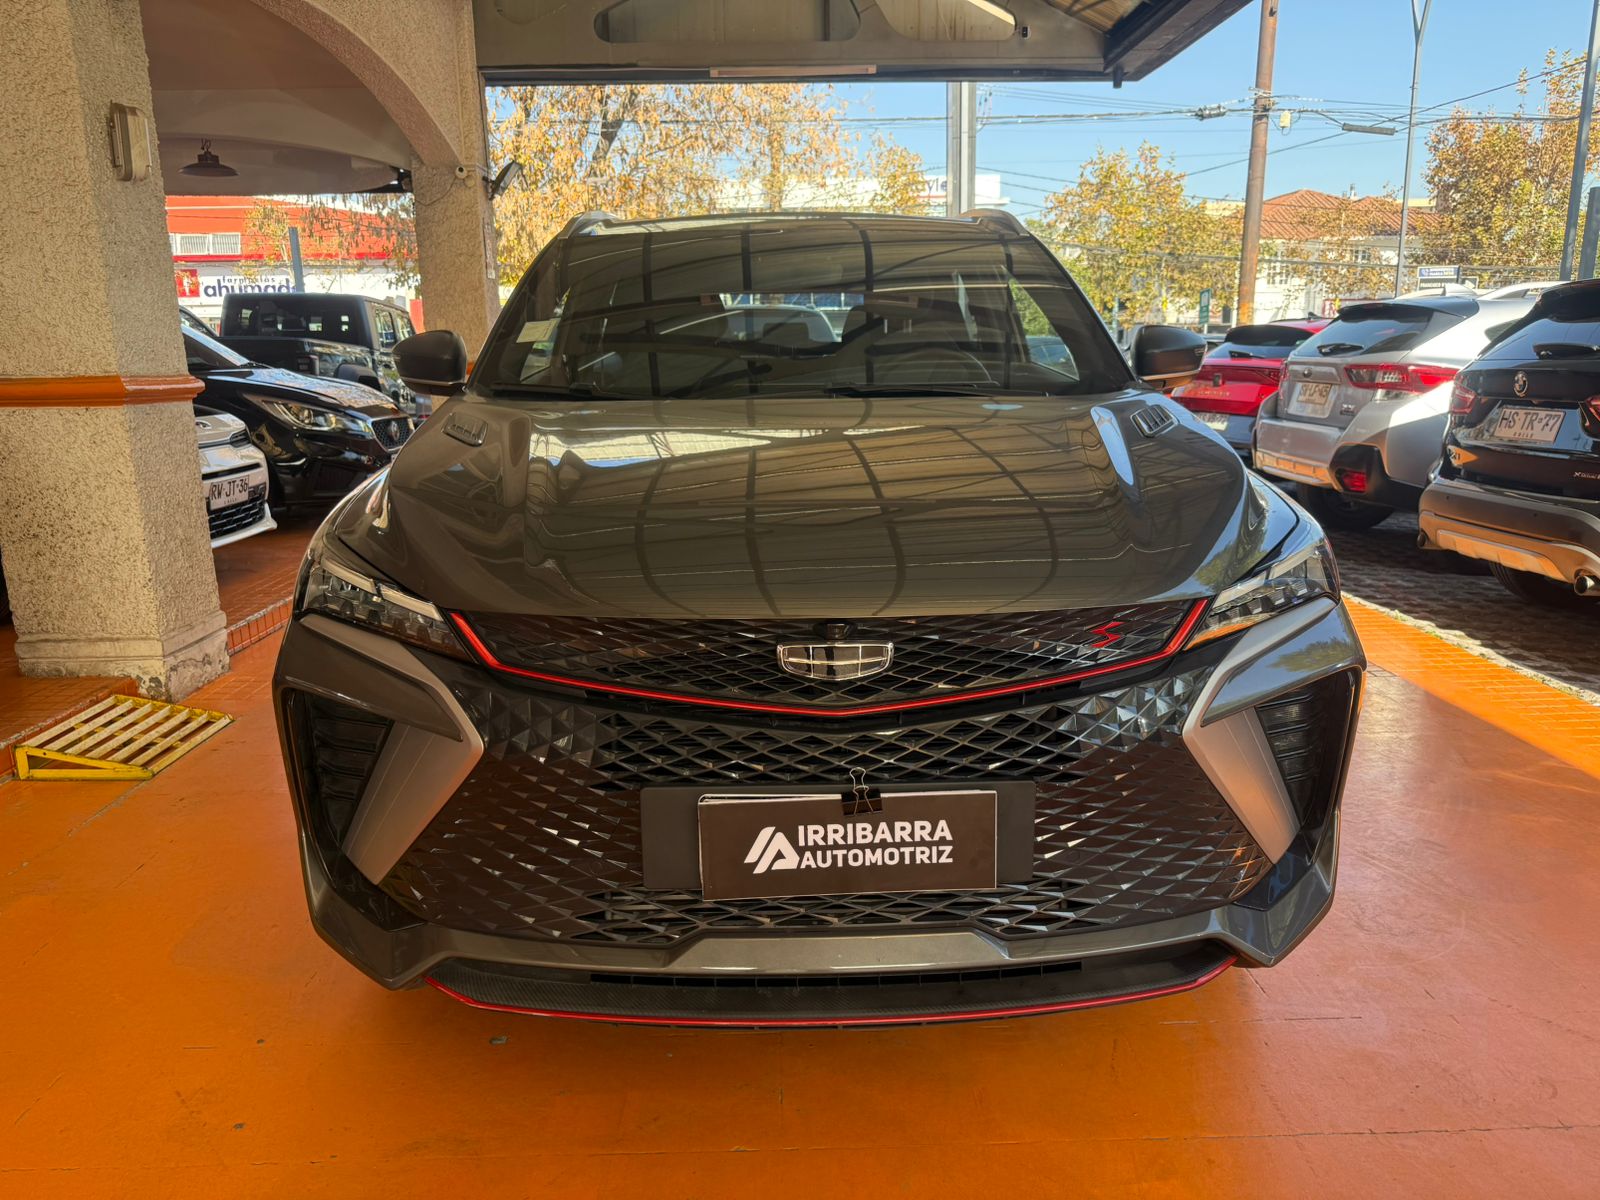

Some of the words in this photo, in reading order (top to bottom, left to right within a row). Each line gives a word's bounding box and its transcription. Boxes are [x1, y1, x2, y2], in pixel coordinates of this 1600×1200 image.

[203, 278, 297, 298] ahumad
[797, 819, 953, 847] IRRIBARRA
[799, 845, 953, 869] AUTOMOTRIZ
